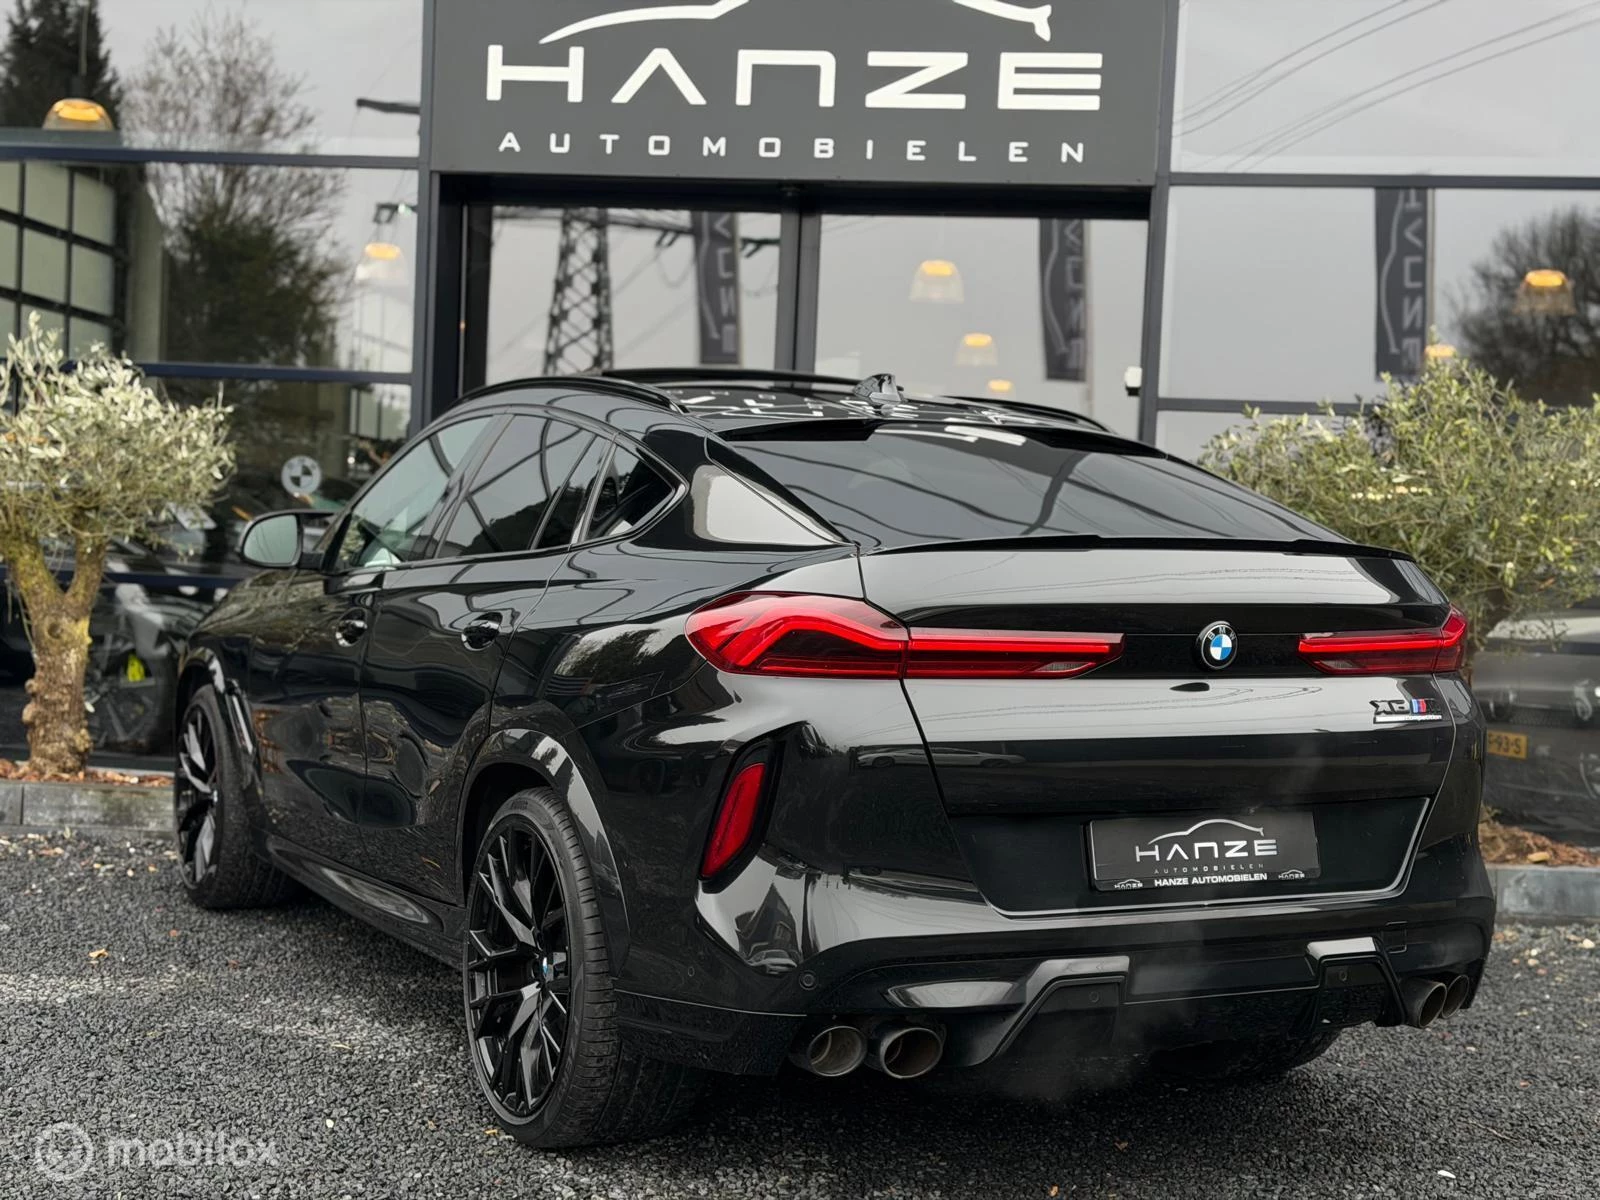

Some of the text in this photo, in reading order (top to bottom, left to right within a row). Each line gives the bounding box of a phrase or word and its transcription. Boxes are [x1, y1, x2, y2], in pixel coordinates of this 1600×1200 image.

[486, 45, 1104, 111] HANZE
[498, 131, 1085, 164] AUTOMOBIELEN
[1135, 839, 1278, 862] HANZE
[1154, 863, 1265, 874] AUTOMOBIELEN
[1154, 872, 1268, 888] HANZE AUTOMOBIELEN
